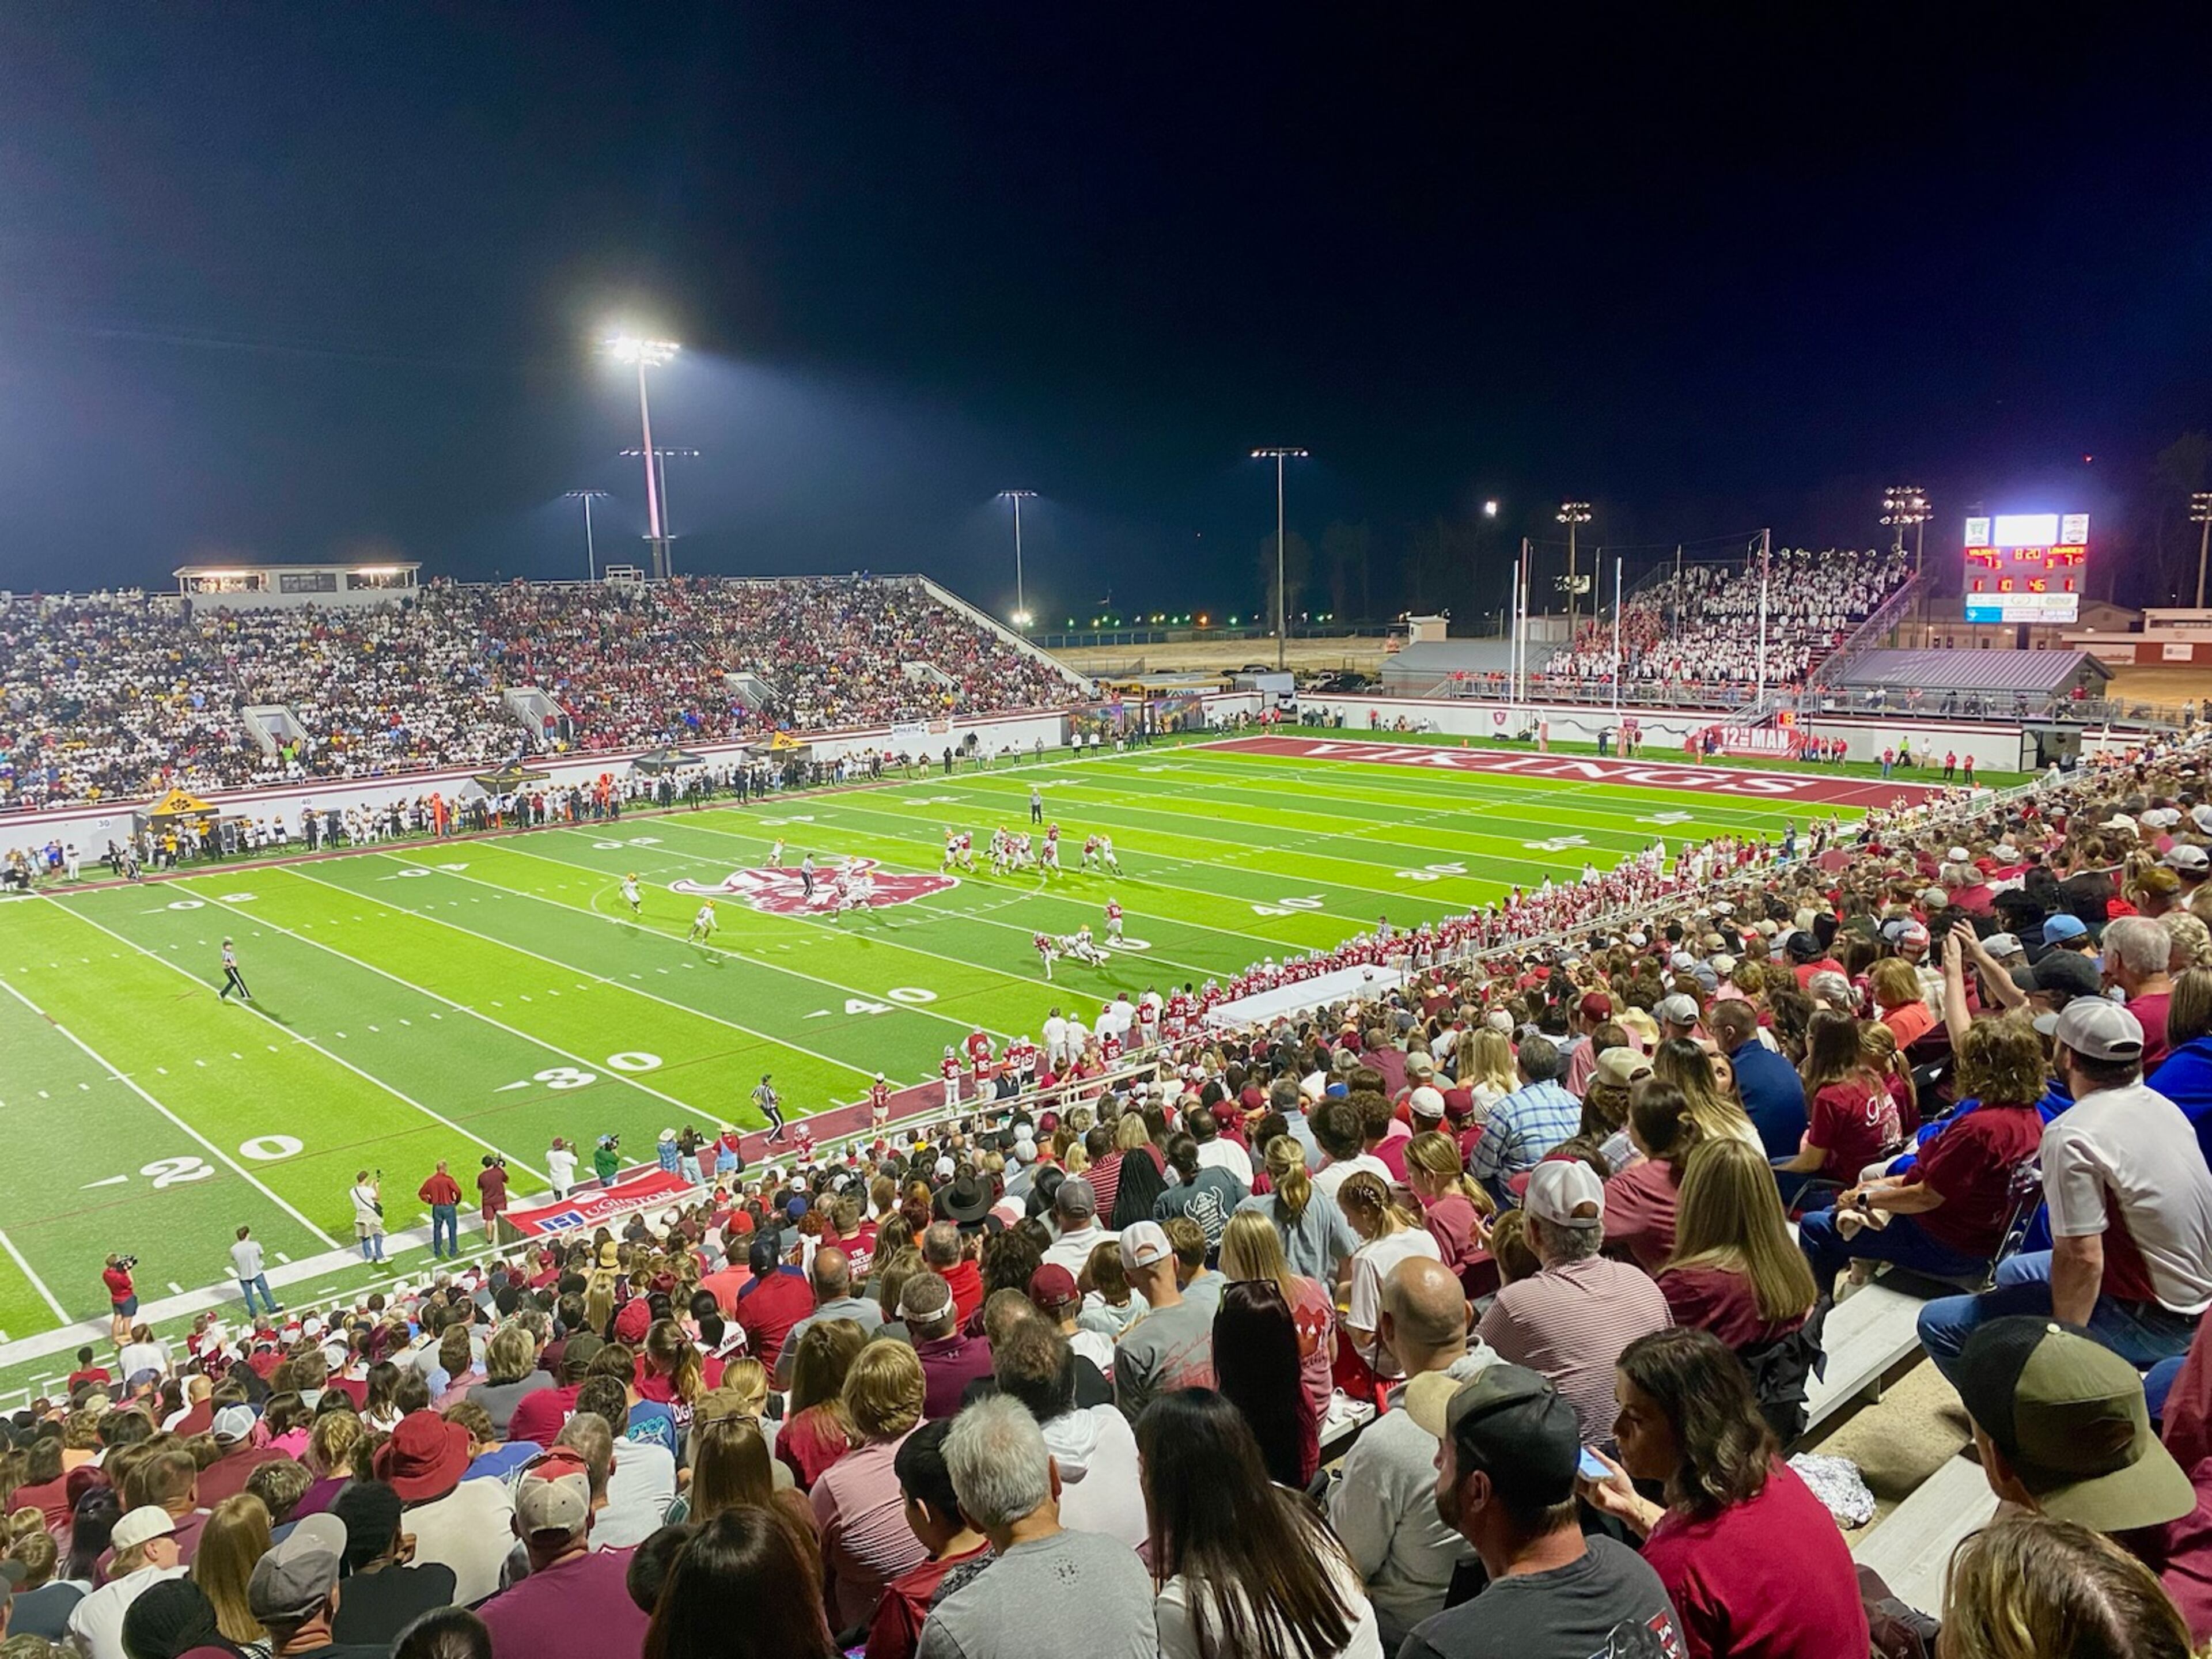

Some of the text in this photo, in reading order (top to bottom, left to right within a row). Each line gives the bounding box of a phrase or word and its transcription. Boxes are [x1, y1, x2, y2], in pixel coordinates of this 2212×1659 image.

[1751, 728, 1789, 749] MAN
[1303, 743, 1819, 793] VIKINGS
[533, 1051, 663, 1090] 30
[139, 1134, 304, 1189] 20
